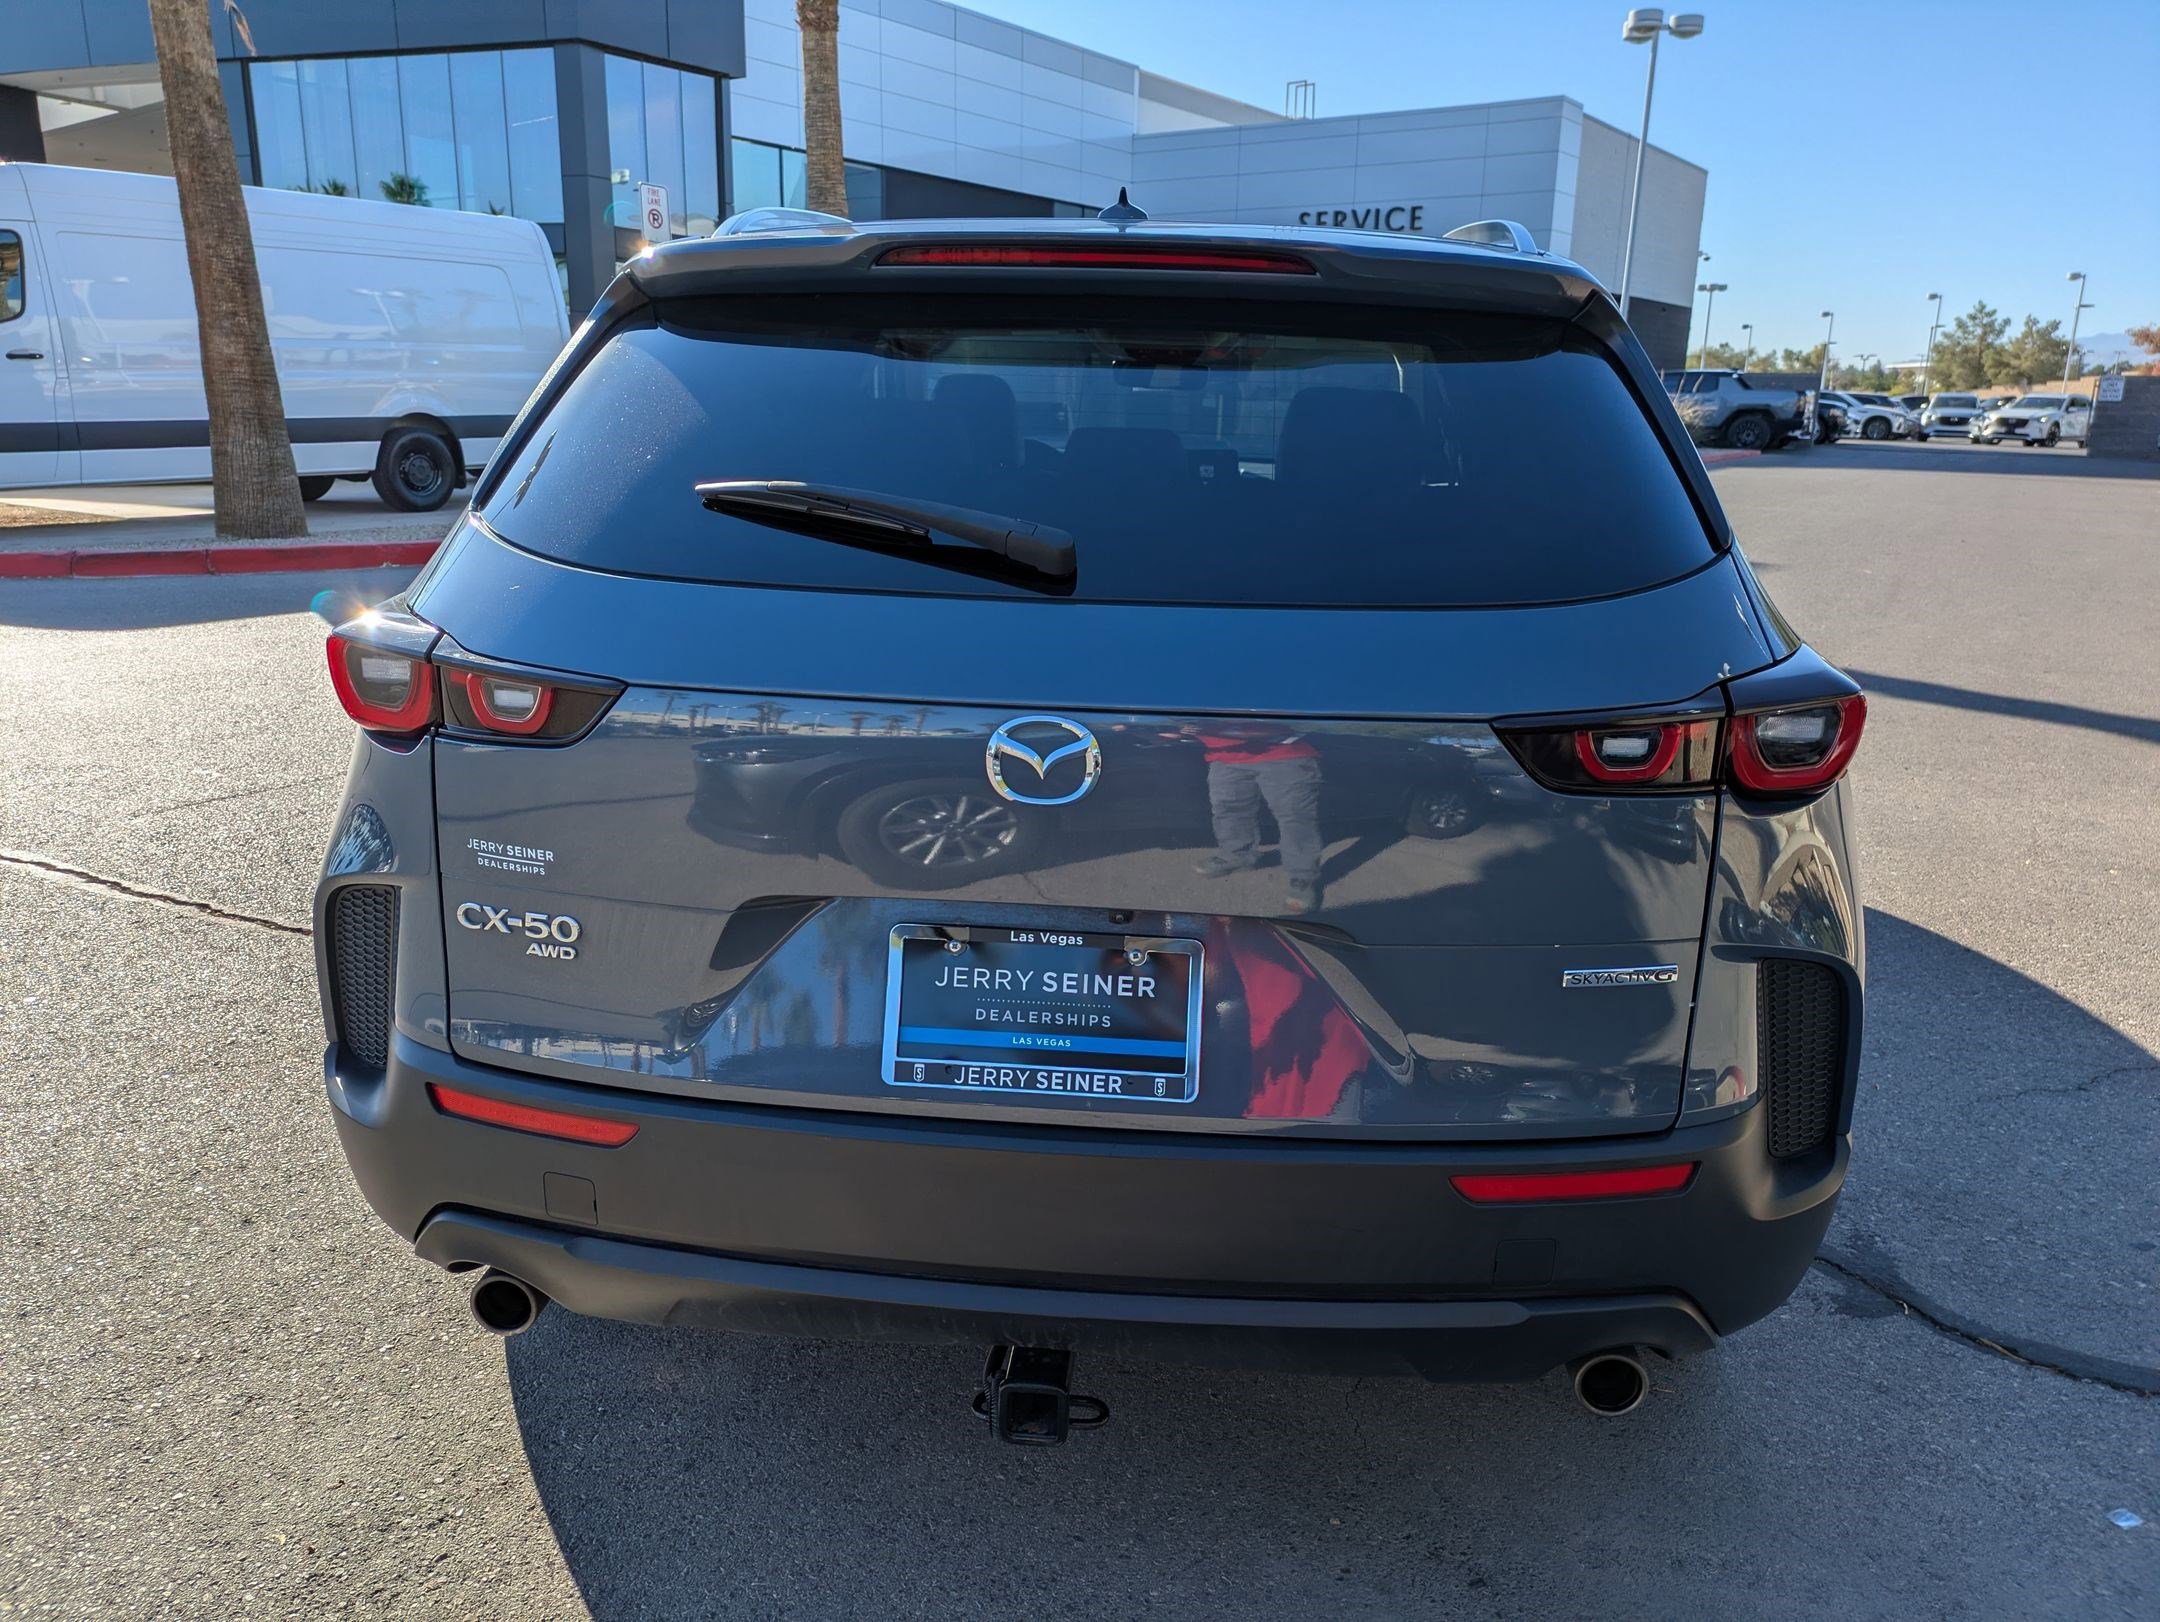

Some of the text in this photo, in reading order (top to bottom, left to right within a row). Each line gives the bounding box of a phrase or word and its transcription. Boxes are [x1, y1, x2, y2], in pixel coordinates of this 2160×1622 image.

[1298, 205, 1424, 231] SERVICE
[467, 838, 554, 862] JERRY SEINER
[477, 857, 546, 875] DEALERSHIPS
[456, 902, 582, 943] CX-50
[1010, 930, 1083, 946] Las Vegas
[526, 943, 577, 960] AWD
[935, 966, 1156, 998] JERRY SEINER
[975, 1008, 1112, 1028] DEALERSHIPS
[1012, 1036, 1071, 1048] LAS VEGAS
[954, 1066, 1122, 1094] JERRY SEINER
